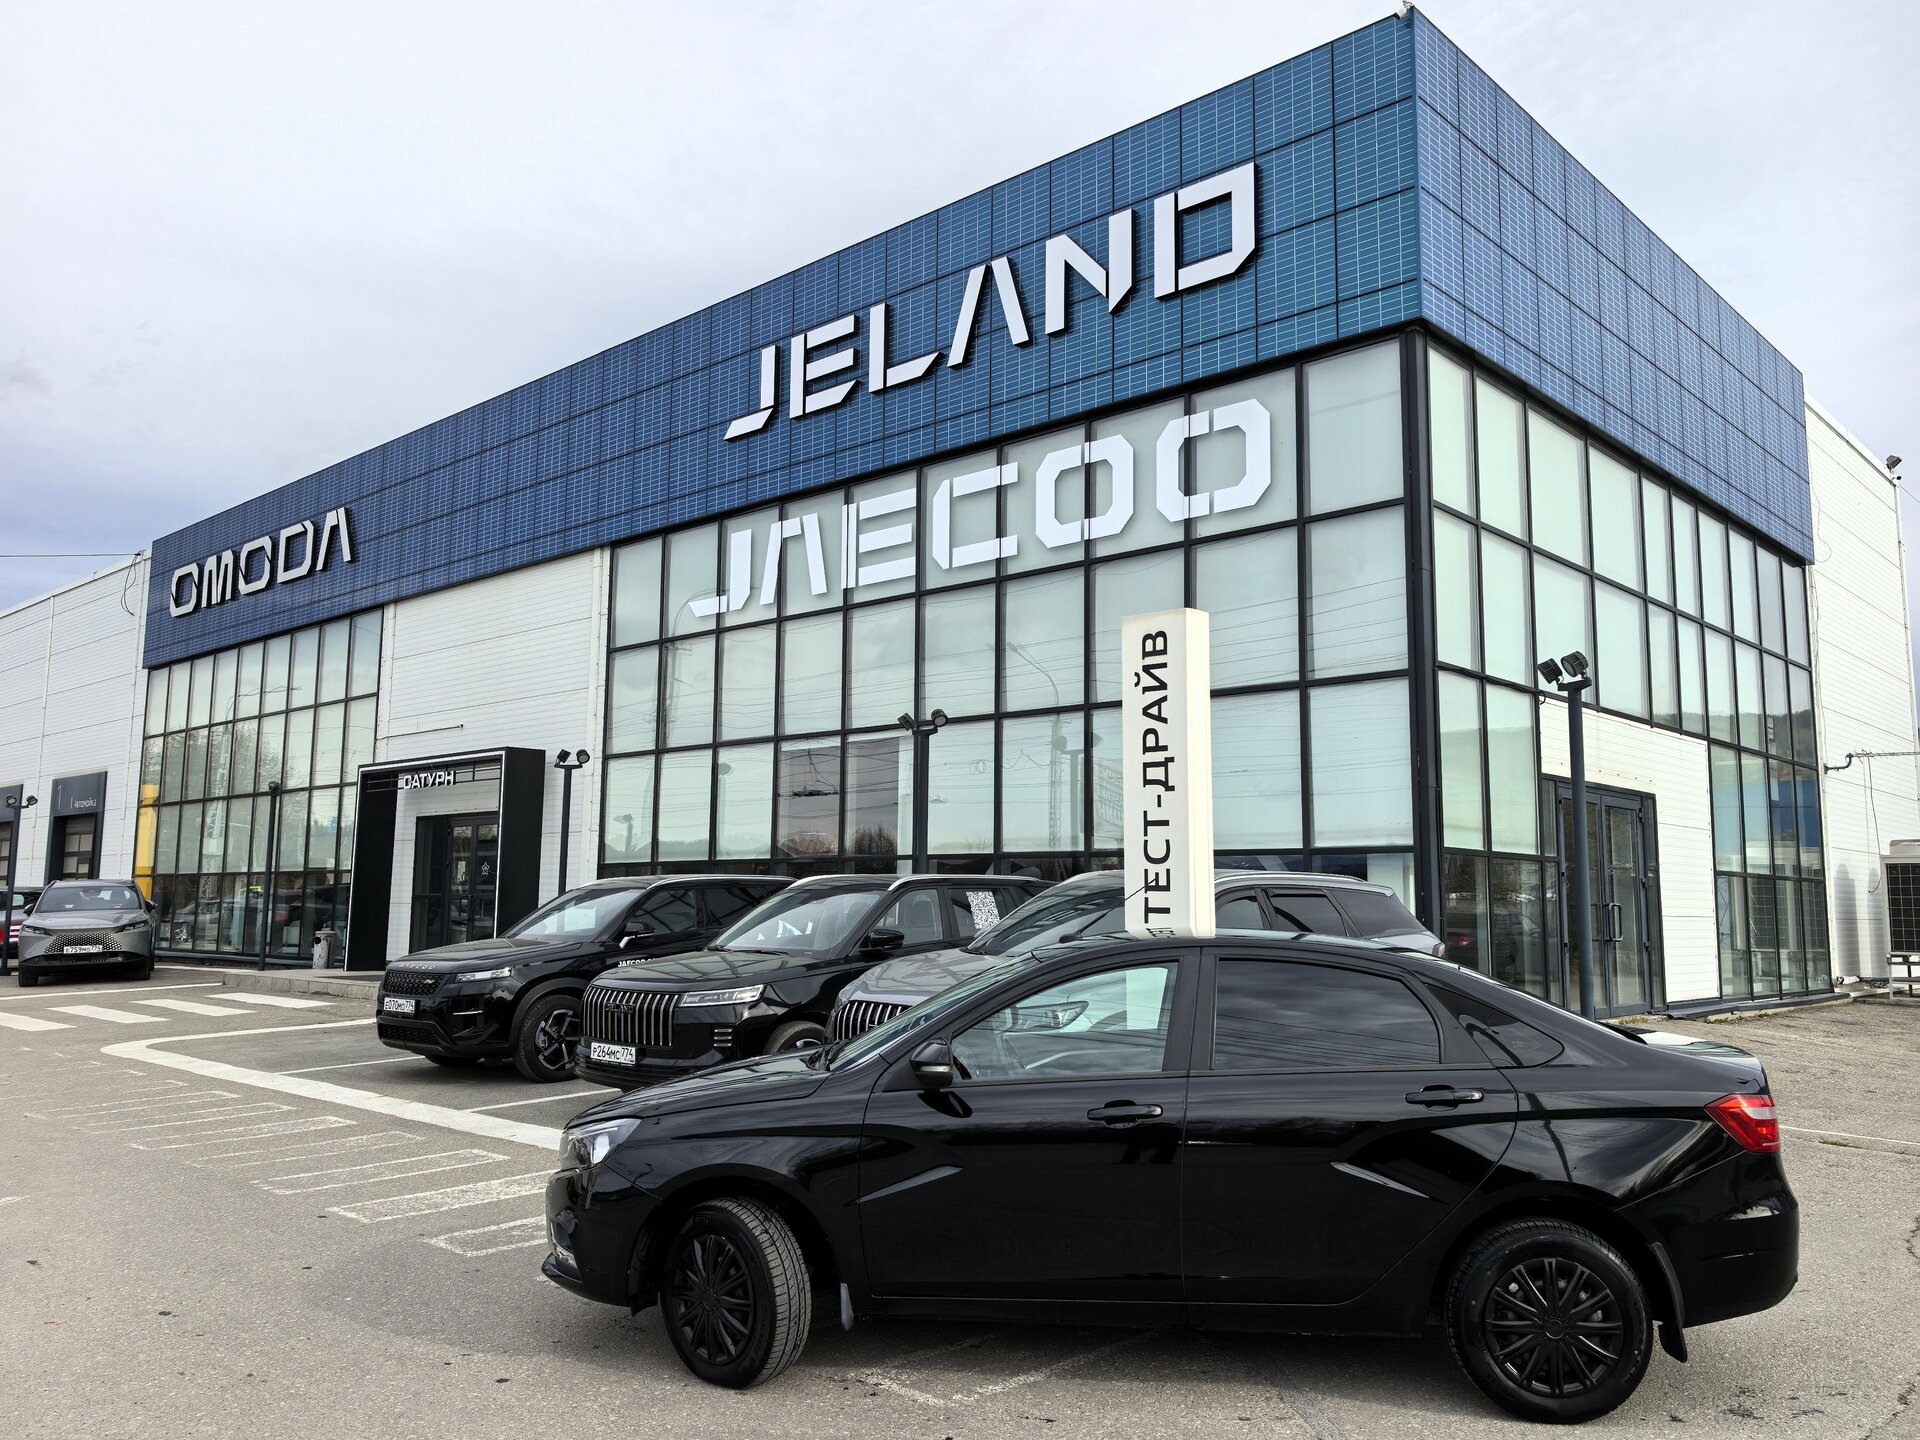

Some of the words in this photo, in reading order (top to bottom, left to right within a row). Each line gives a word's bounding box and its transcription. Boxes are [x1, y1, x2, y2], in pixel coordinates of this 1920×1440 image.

[723, 162, 1256, 441] JELAND
[169, 506, 352, 618] OMODA
[688, 398, 1271, 618] JAECOO
[403, 770, 455, 789] САТУРН
[1134, 629, 1176, 924] ТЕСТ-ДРАЙВ
